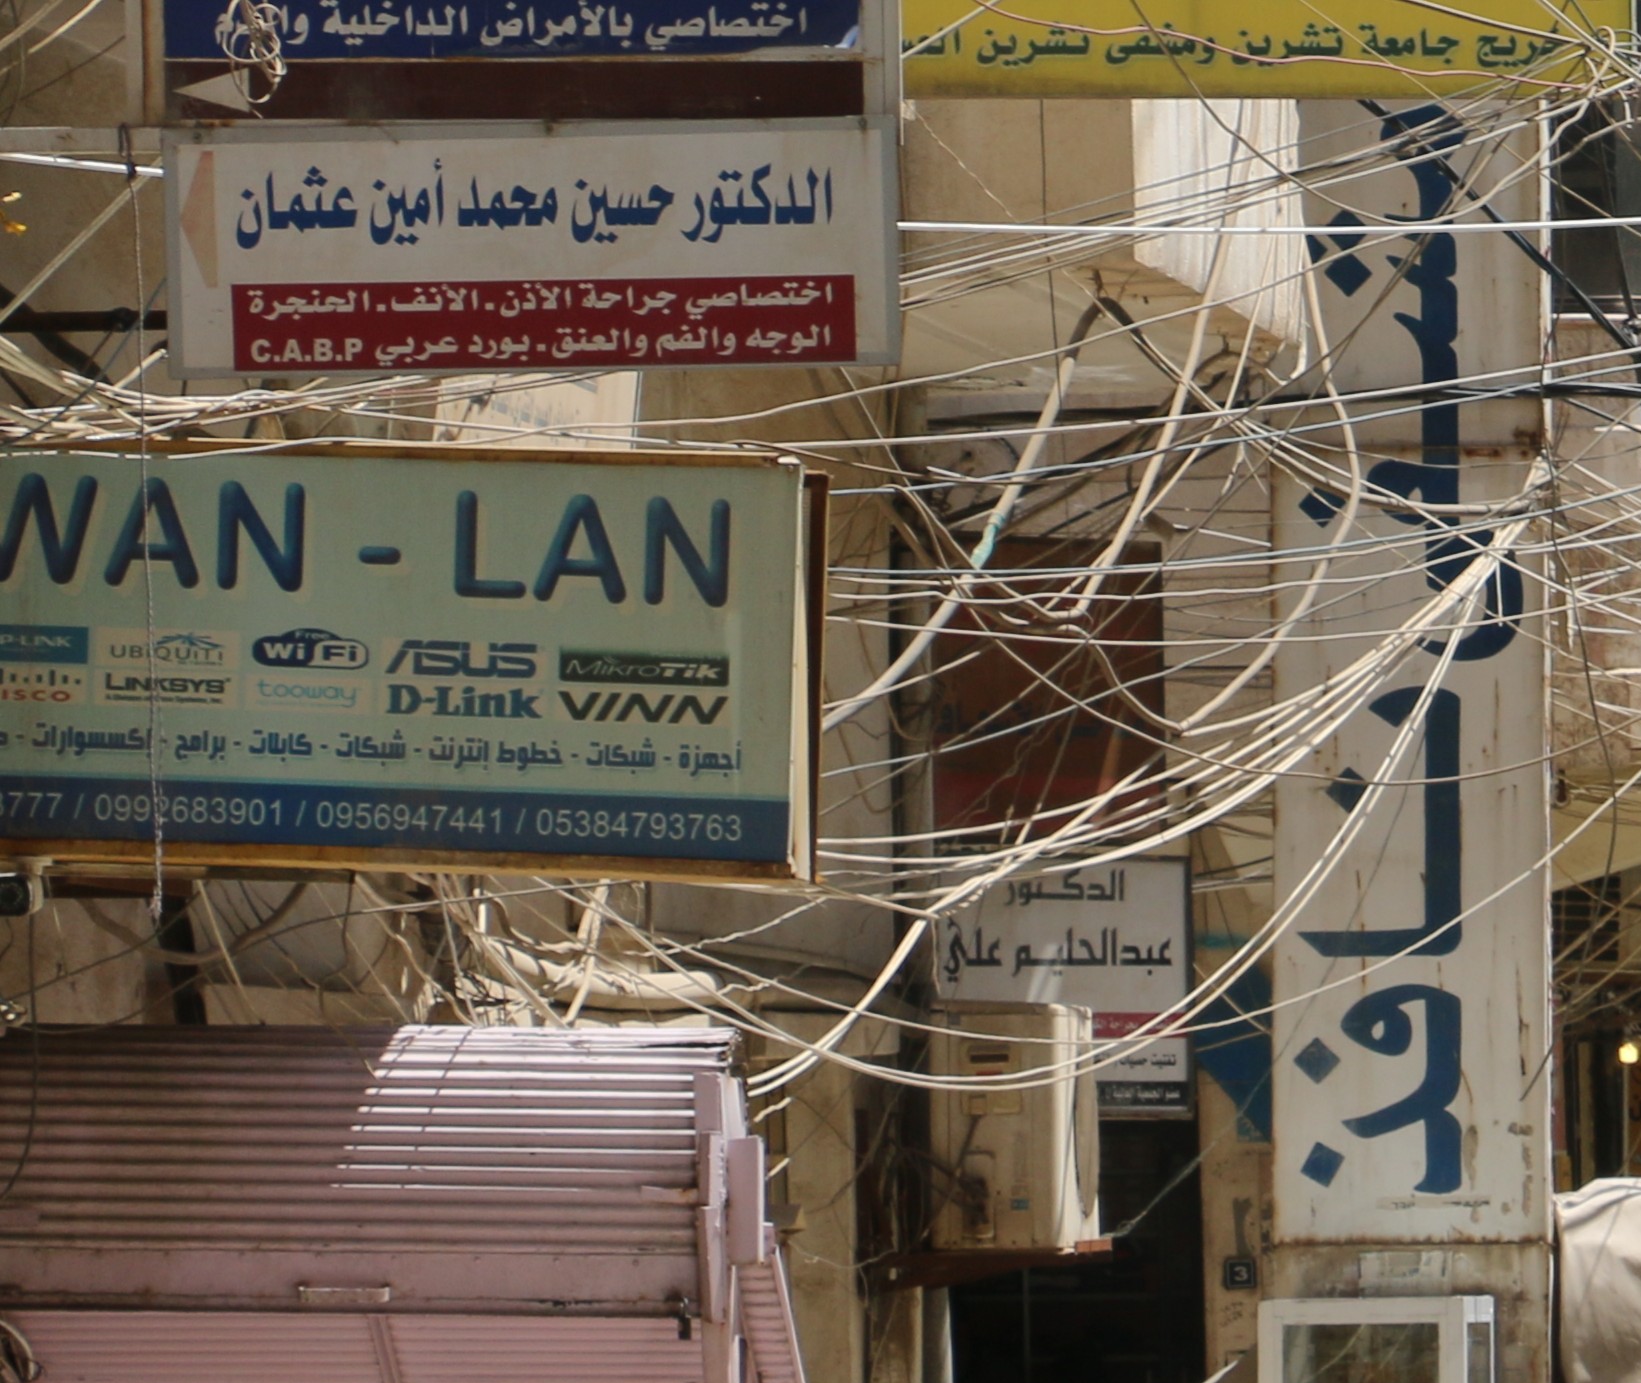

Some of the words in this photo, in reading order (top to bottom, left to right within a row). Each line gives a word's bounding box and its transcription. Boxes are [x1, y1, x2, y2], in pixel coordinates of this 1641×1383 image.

[321, 0, 467, 45] الداخلية
[1105, 22, 1217, 65] ومشفى
[1231, 22, 1344, 67] تشرين
[1359, 24, 1460, 65] جامعة
[234, 164, 361, 251] عثمان
[368, 157, 446, 247] أمين
[456, 170, 560, 230] محمد
[568, 175, 676, 247] حسين
[683, 164, 835, 244] الدكتور
[247, 288, 372, 322] الحنجرة
[579, 284, 681, 325] جراحة
[685, 281, 835, 325] اختصاصي
[249, 336, 363, 366] C.A.B.P
[374, 335, 460, 368] عربي
[467, 330, 530, 364] بورد
[653, 328, 740, 360] والفم
[744, 324, 834, 356] الوجه
[0, 472, 306, 594] WAN
[453, 490, 732, 609] LAN
[385, 639, 538, 679] ASUS
[386, 683, 544, 720] D-Link
[173, 729, 228, 760] برامج
[248, 729, 314, 763] كابلات
[335, 728, 407, 767] شبكات
[496, 740, 564, 771] خطوط
[585, 737, 656, 775] شبكات
[677, 740, 743, 777] أجهزة
[316, 801, 502, 832] 0956947441
[535, 808, 743, 841] 05384793763
[1001, 868, 1125, 907] الدكتور
[1010, 926, 1174, 977] عبدالحليم
[1233, 1266, 1249, 1282] 3
